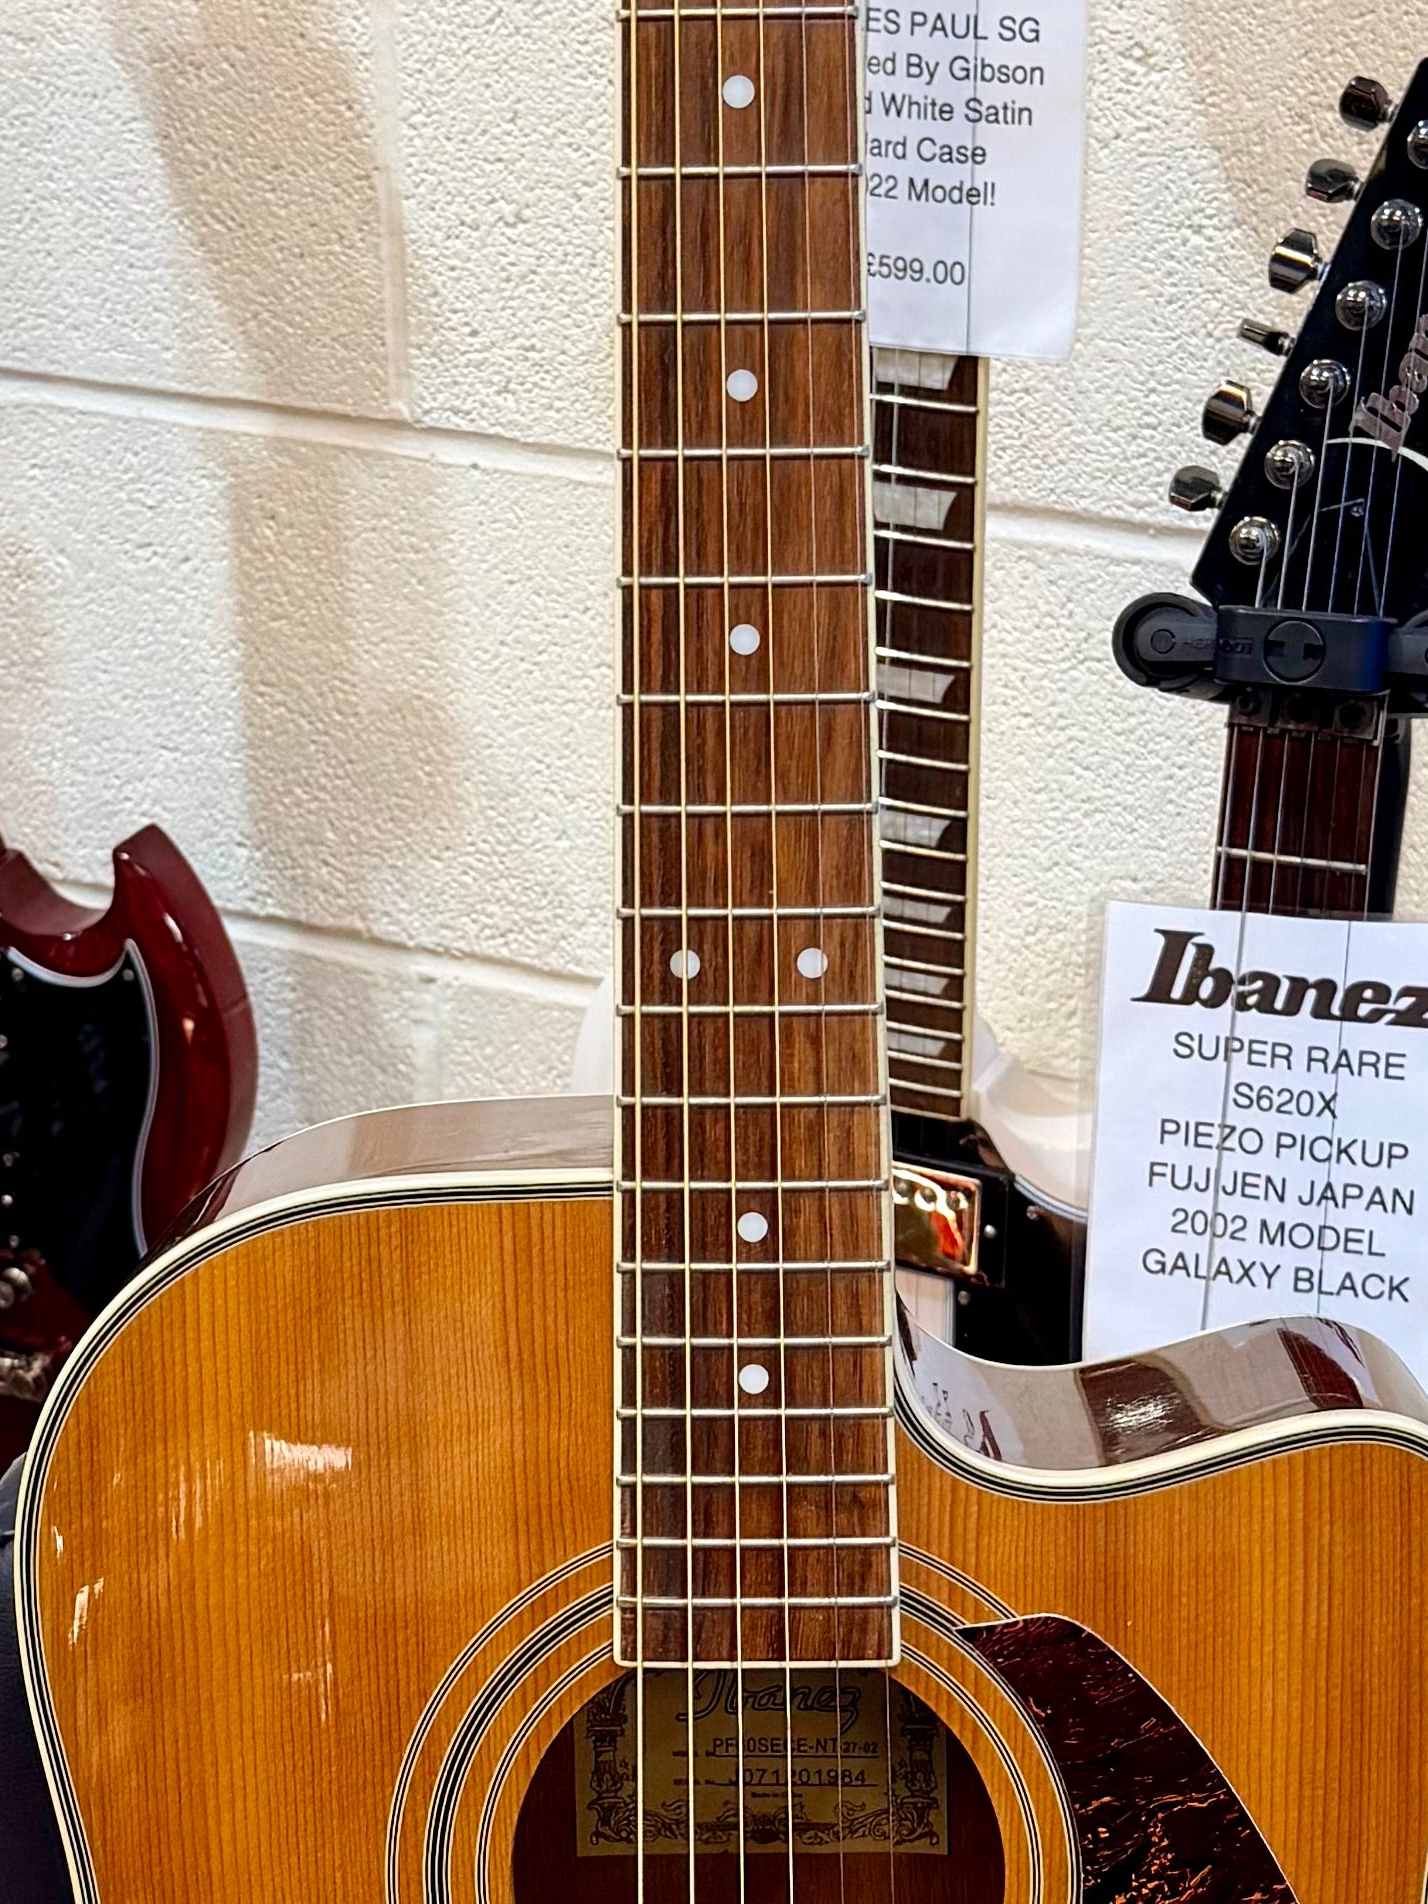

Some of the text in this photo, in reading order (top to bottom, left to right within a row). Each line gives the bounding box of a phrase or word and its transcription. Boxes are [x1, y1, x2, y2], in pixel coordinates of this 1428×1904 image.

[864, 7, 1042, 44] ES PAUL SG
[906, 53, 940, 86] By
[949, 55, 1045, 86] Gibson
[881, 94, 954, 123] White
[964, 97, 1034, 127] Satin
[865, 134, 988, 166] ard Case
[865, 174, 998, 208] 22 Model!
[867, 253, 966, 287] £599.00
[1172, 1032, 1407, 1080] SUPER RARE
[1232, 1082, 1339, 1119] S620X
[1159, 1118, 1409, 1170] PIEZO PICKUP
[1148, 1161, 1415, 1216] FUJJEN JAPAN
[1171, 1208, 1386, 1257] 2002 MODEL
[1142, 1248, 1410, 1303] GALAXY BLACK
[675, 1669, 862, 1736] Ibanez
[729, 1768, 866, 1785] 07101984
